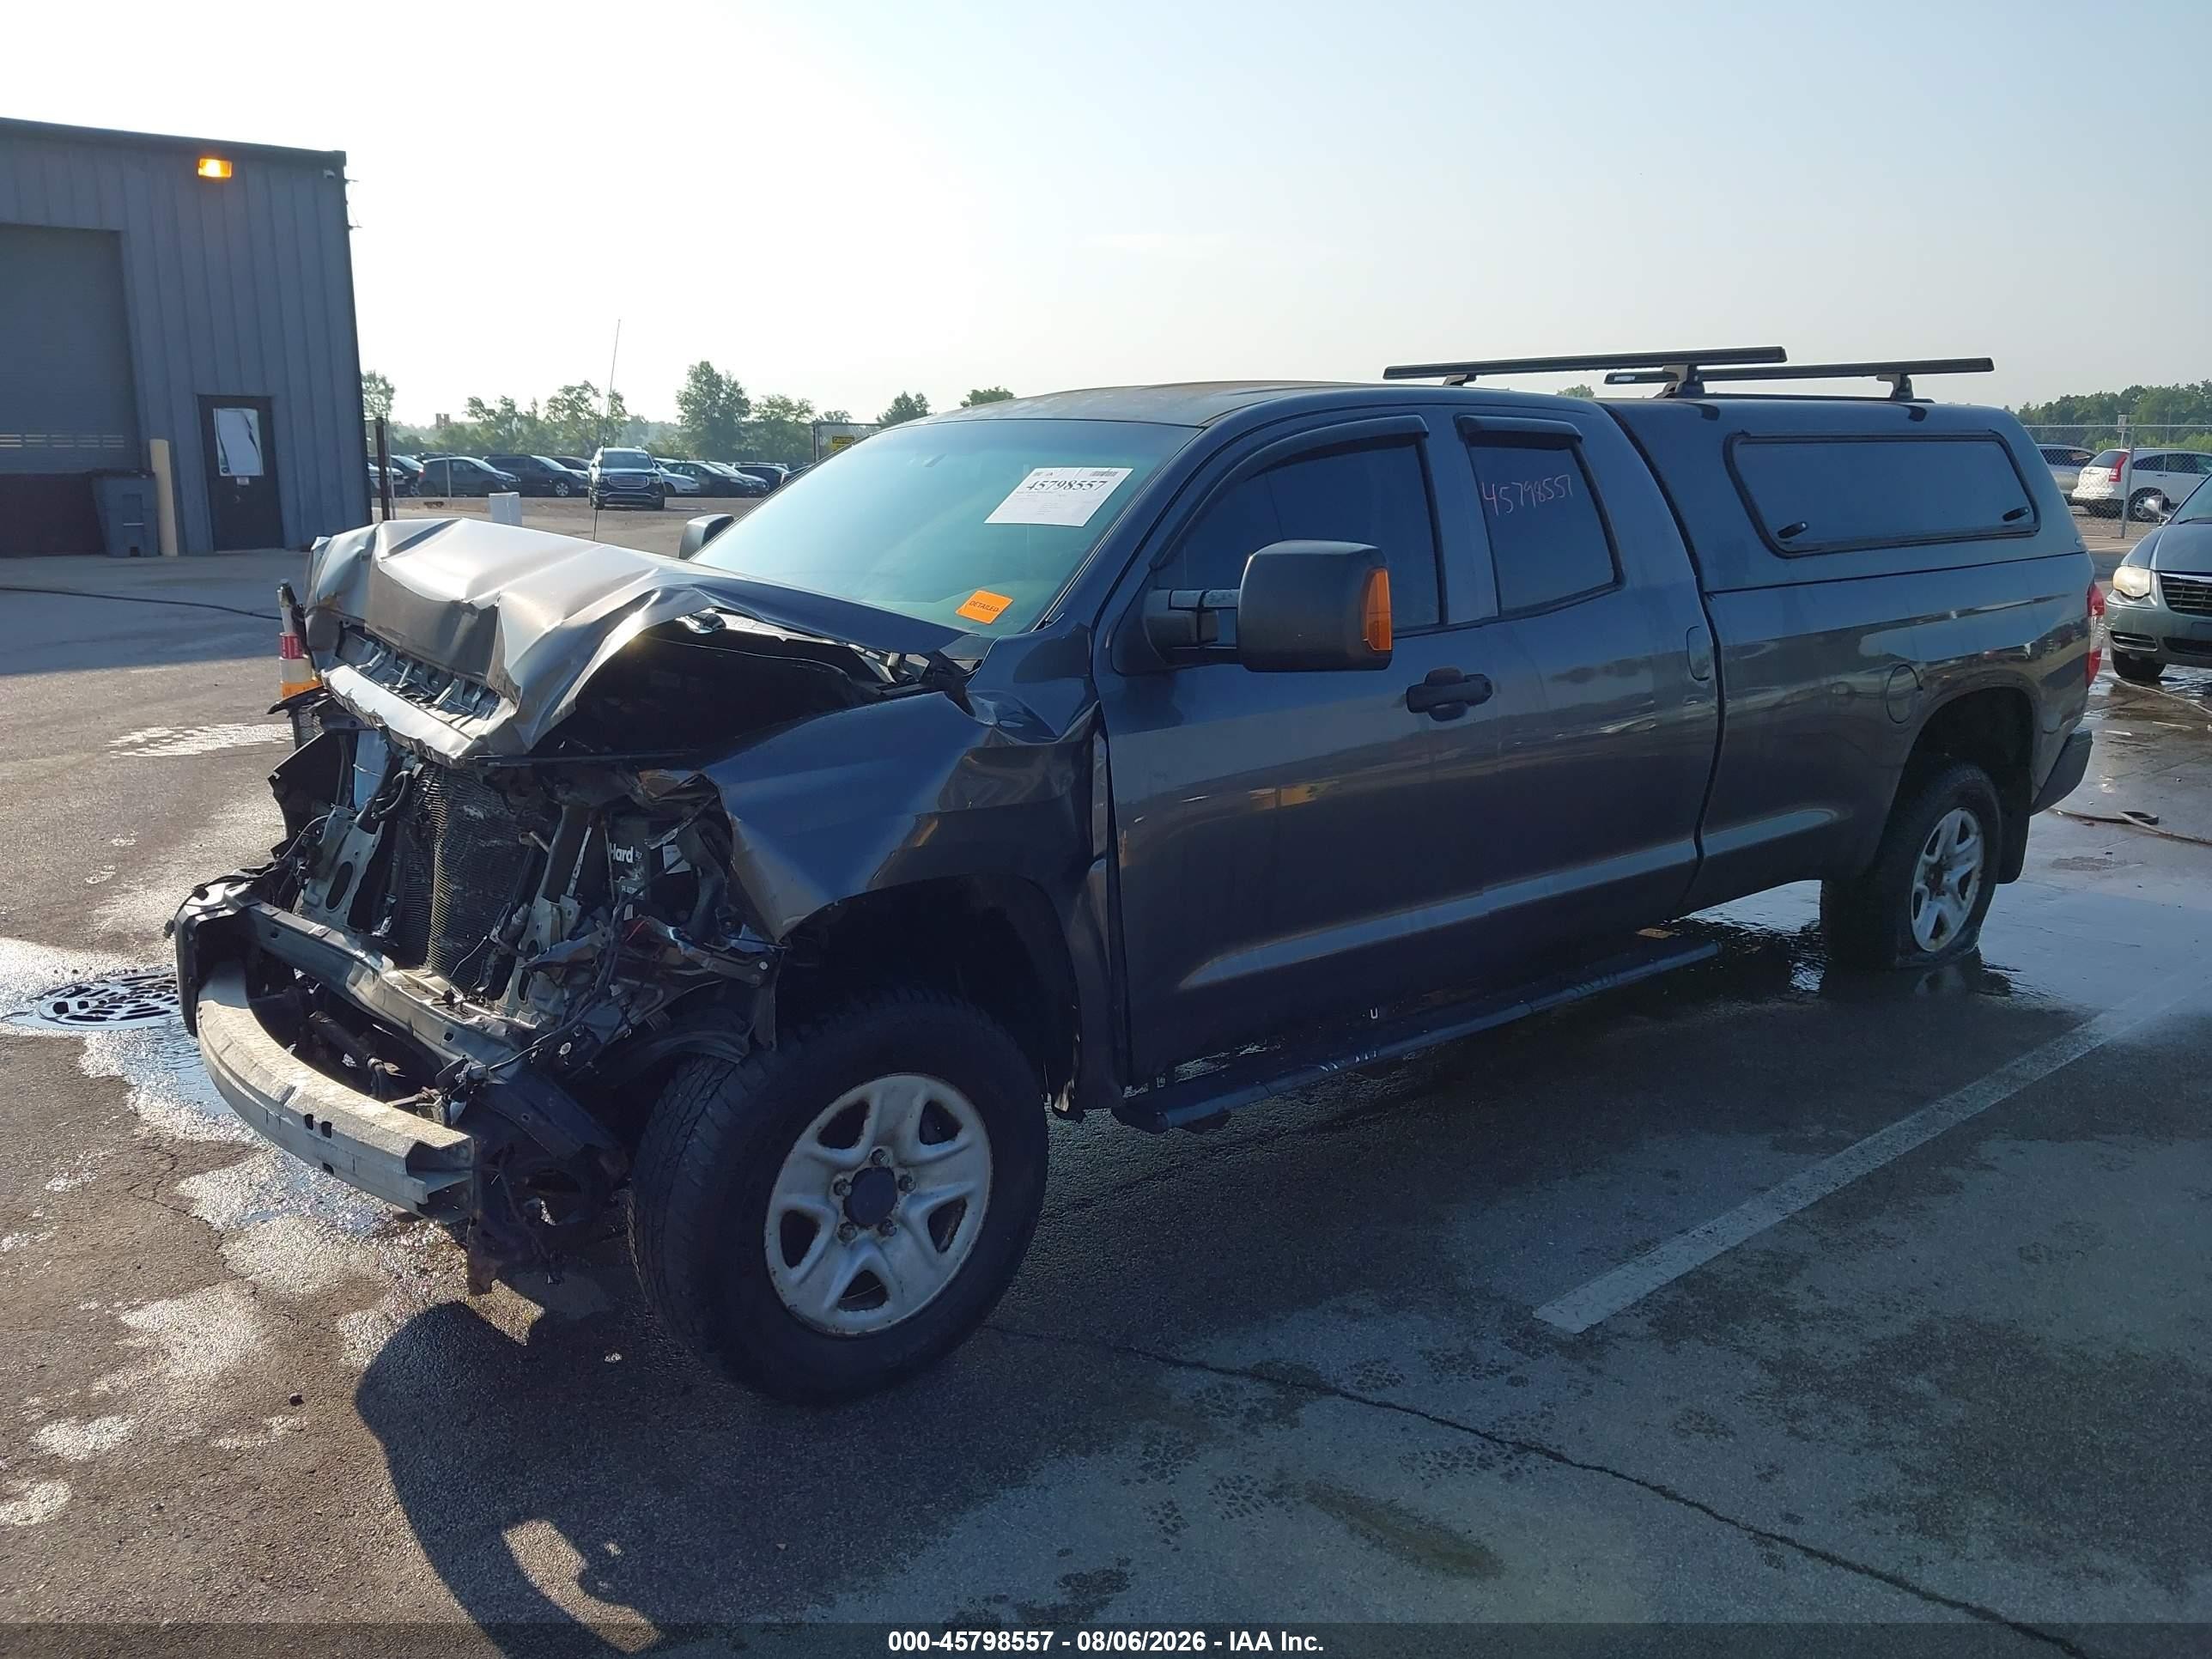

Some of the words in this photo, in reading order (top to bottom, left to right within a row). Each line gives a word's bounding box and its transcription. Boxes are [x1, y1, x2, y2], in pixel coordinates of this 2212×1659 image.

[1026, 479, 1109, 492] 45798557
[1480, 474, 1573, 516] 45798557
[969, 600, 1000, 612] DETAILED
